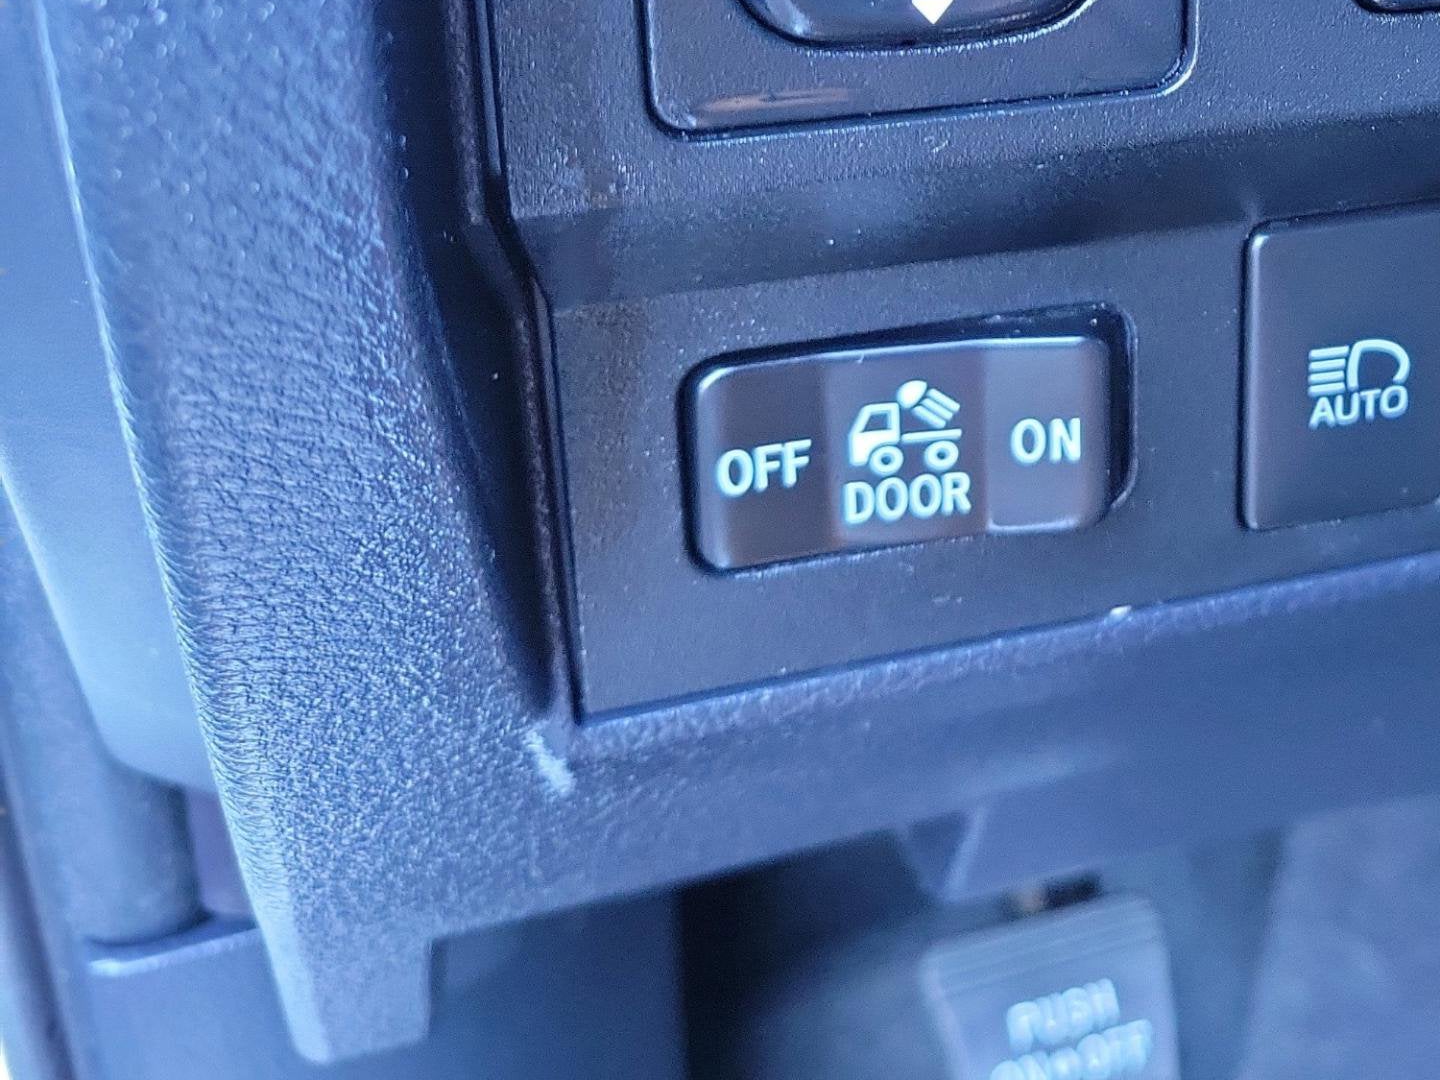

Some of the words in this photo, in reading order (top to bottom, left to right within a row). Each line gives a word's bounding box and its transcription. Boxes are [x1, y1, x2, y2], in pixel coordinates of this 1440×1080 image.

[1308, 384, 1409, 430] AUTO
[1010, 416, 1082, 464] ON
[715, 438, 812, 497] OFF
[843, 471, 972, 527] DOOR
